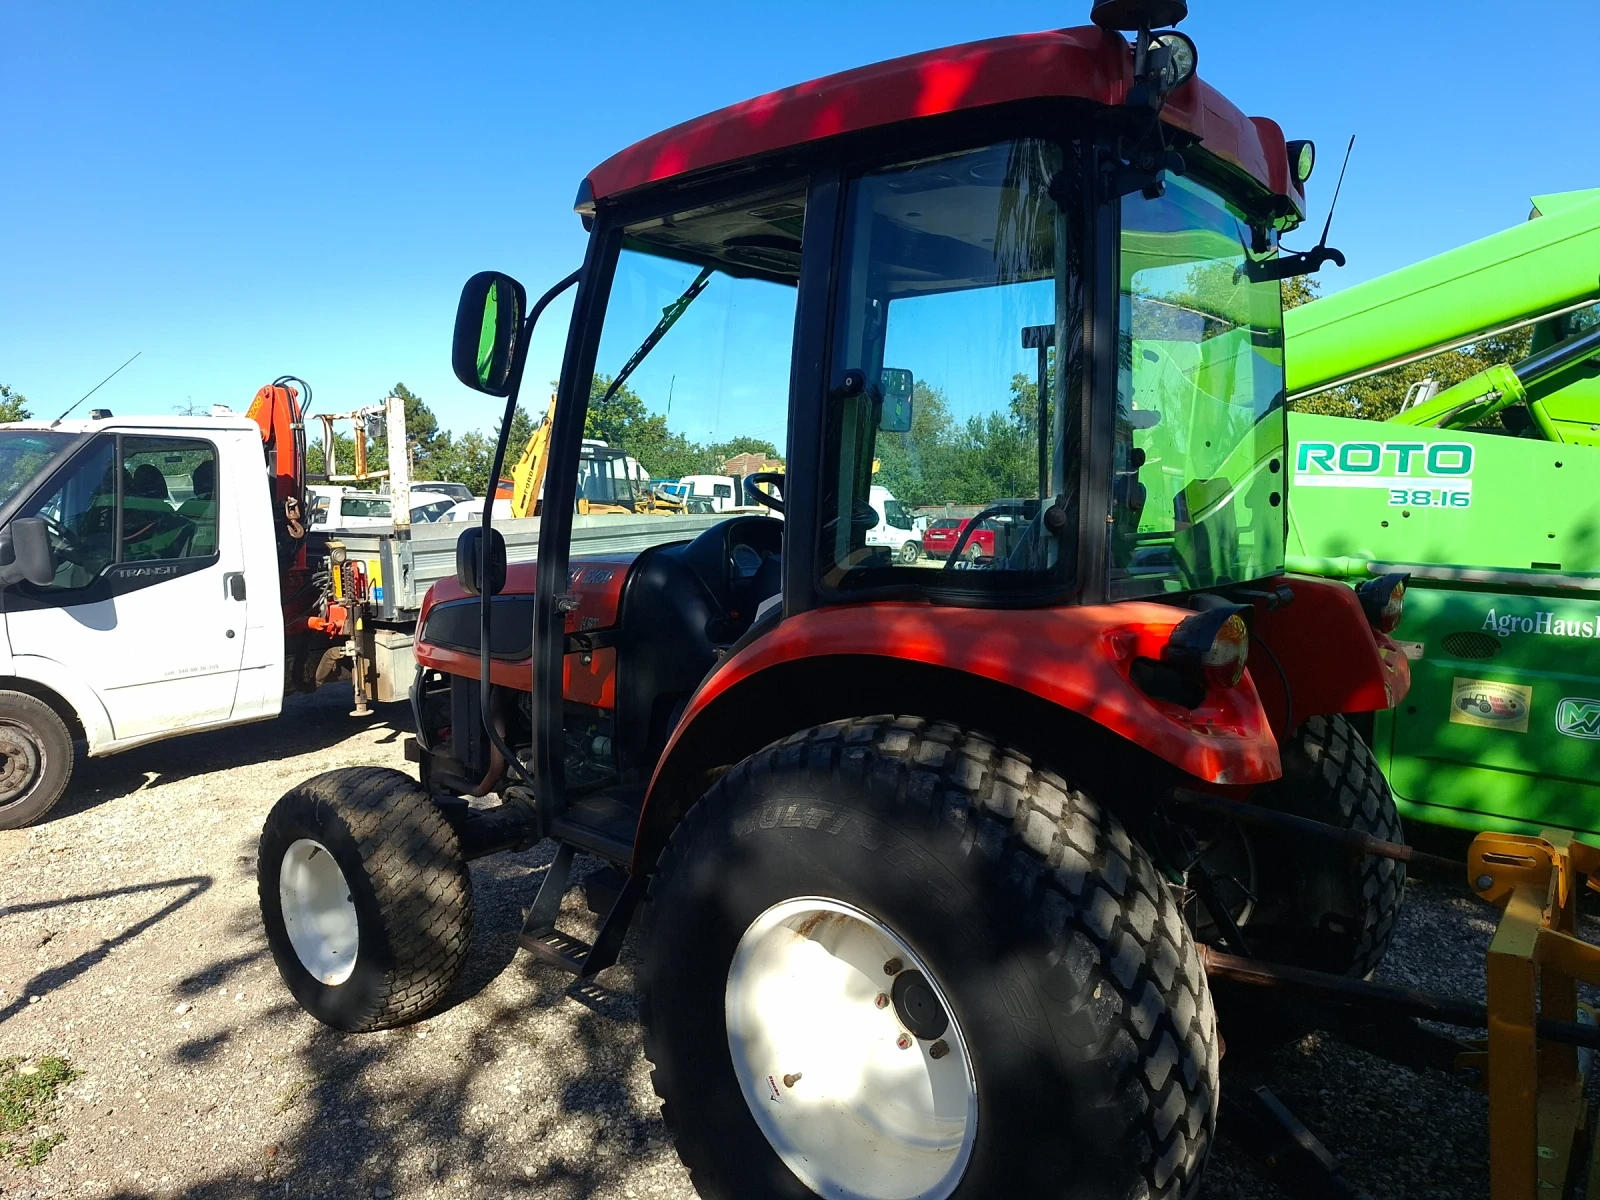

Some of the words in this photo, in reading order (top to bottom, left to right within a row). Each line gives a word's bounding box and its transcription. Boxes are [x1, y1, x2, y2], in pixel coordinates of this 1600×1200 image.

[1296, 442, 1473, 476] ROTO
[524, 471, 534, 495] FORD
[1389, 489, 1470, 507] 38.16
[117, 565, 179, 578] TRANSIT
[733, 803, 849, 838] MULTI
